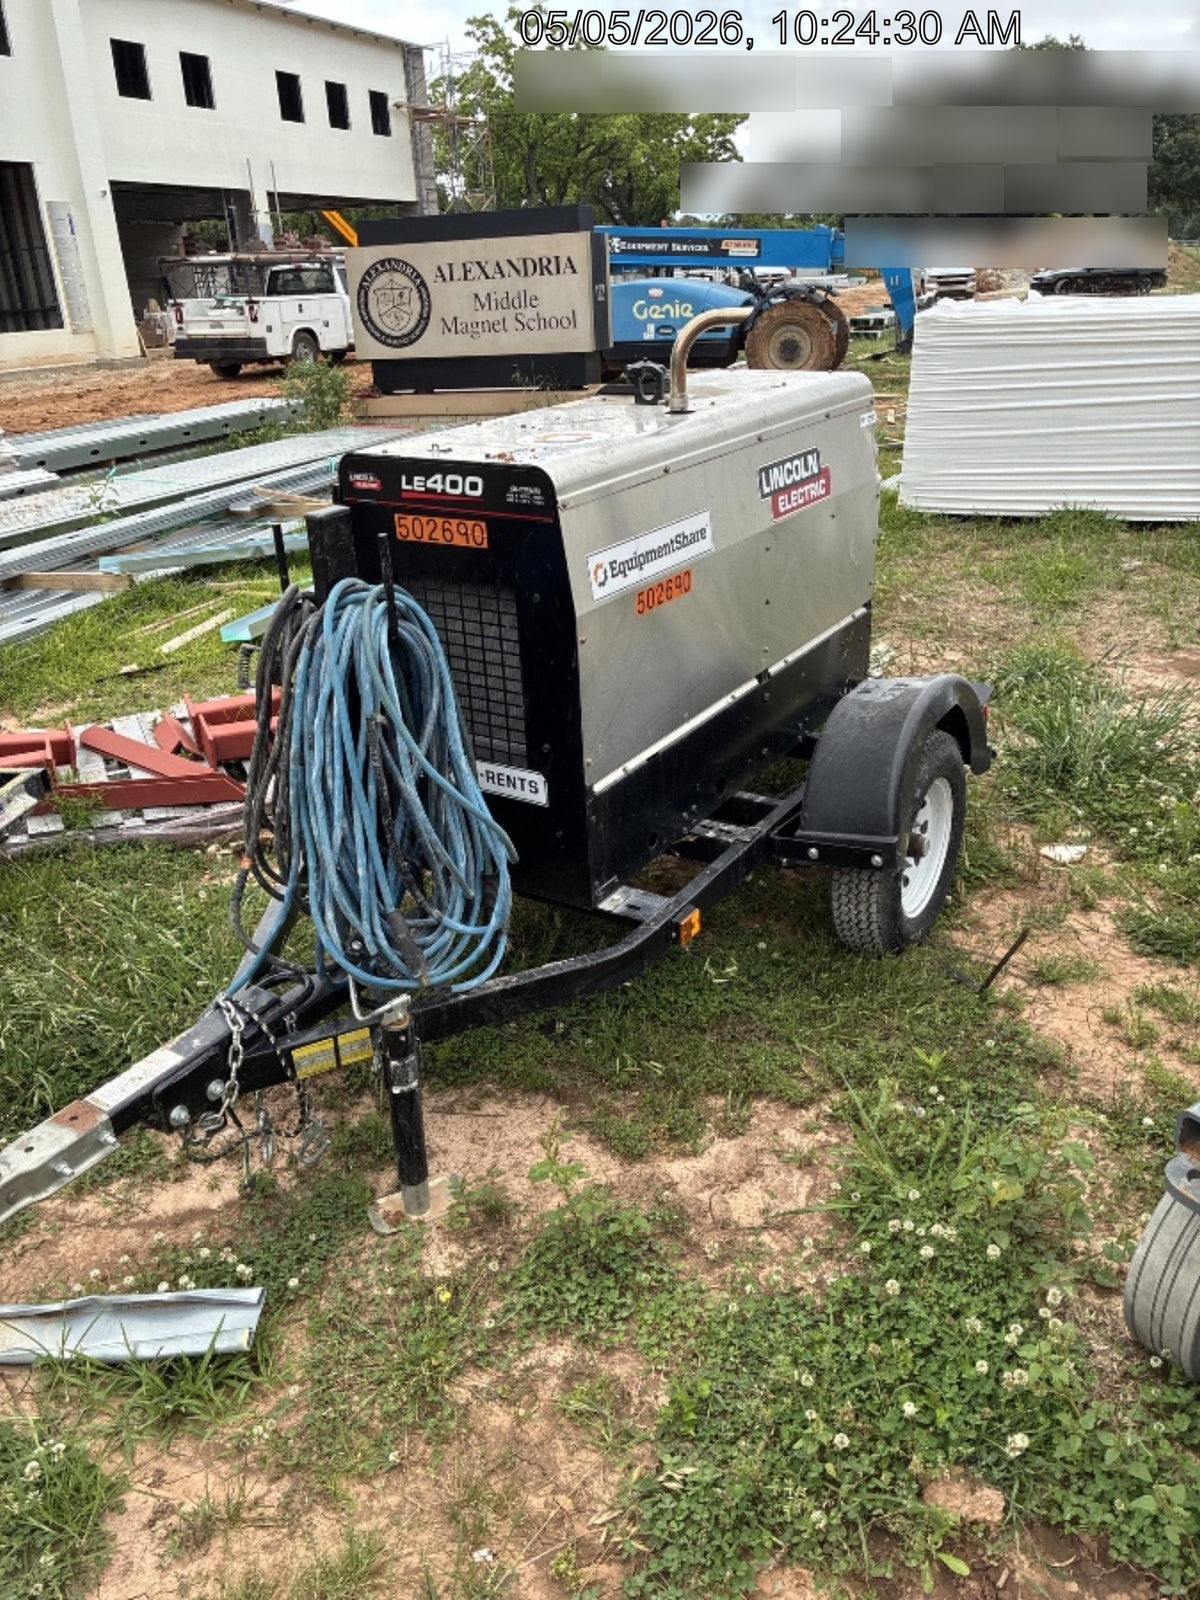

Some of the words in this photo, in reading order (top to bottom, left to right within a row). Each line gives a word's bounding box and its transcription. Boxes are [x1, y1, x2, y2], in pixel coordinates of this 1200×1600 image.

[433, 255, 578, 283] ALEXANDRIA
[473, 289, 540, 312] Middle
[632, 299, 694, 320] Genie
[440, 315, 508, 339] Magnet
[514, 309, 578, 332] School
[401, 474, 484, 497] LE400
[761, 452, 819, 494] LINCOLN
[778, 478, 826, 513] ELECTRIC
[397, 516, 486, 547] 502690
[608, 526, 707, 578] EquipmentShare
[636, 570, 692, 615] 502690
